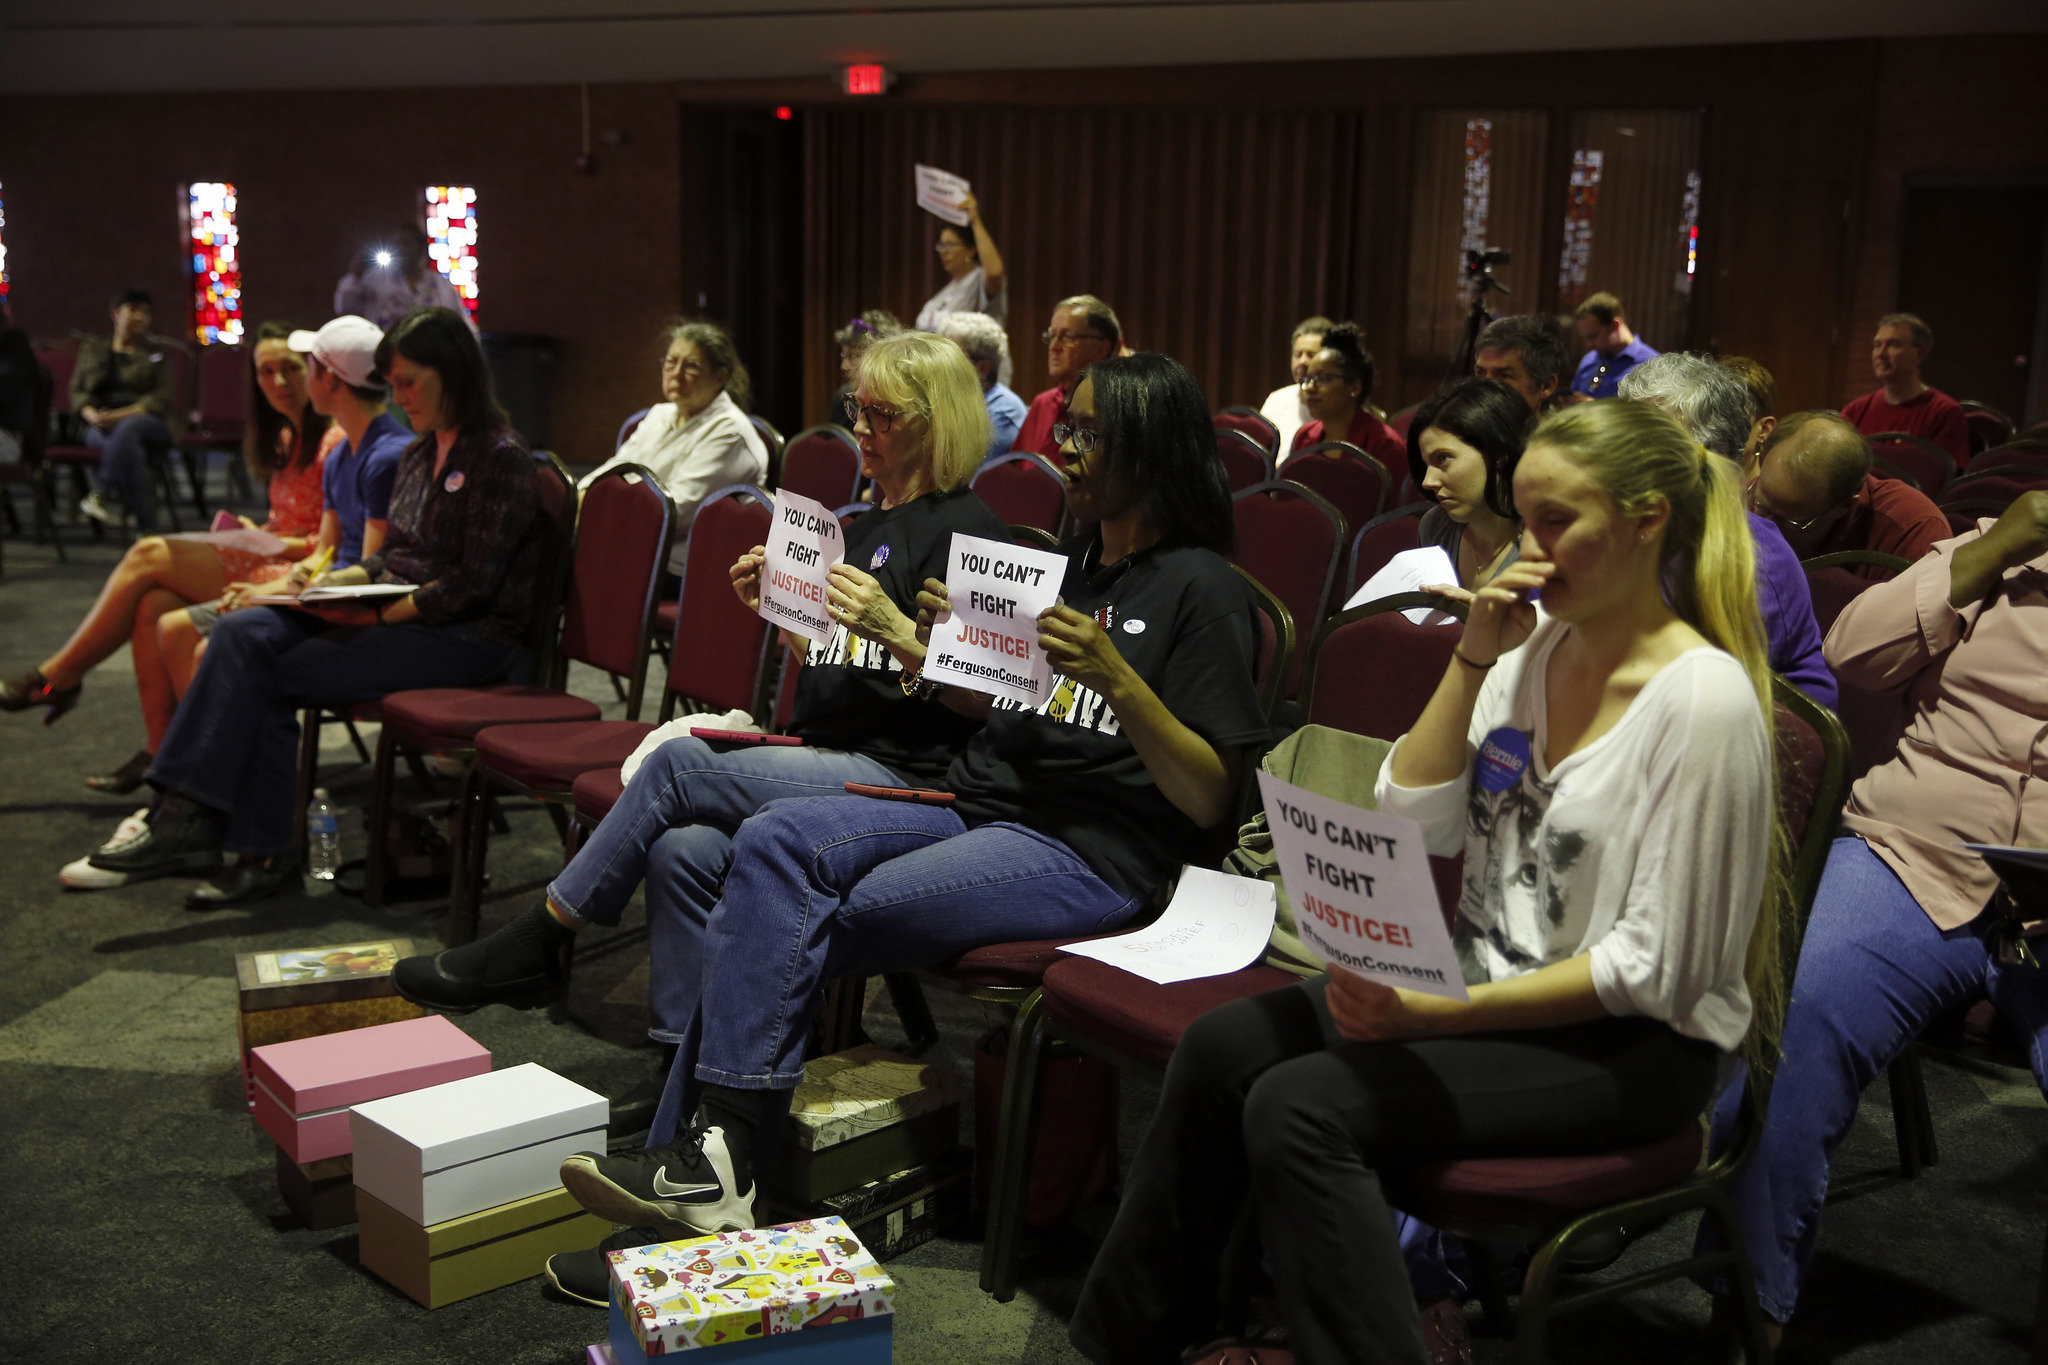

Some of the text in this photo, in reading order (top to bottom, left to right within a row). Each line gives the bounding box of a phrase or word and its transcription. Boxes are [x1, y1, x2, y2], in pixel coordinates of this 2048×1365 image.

[783, 506, 836, 540] YOU CAN'T
[785, 540, 820, 567] FIGHT
[961, 551, 1046, 587] YOU CAN'T
[771, 569, 823, 604] JUSTICE!
[970, 590, 1017, 619] FIGHT
[763, 594, 829, 632] #FergusonConsent
[956, 624, 1030, 660] JUSTICE!
[936, 652, 1039, 692] #FergusonConsent
[1481, 739, 1523, 771] Bernie
[1276, 798, 1397, 860] YOU CAN'T
[1304, 852, 1375, 898] FIGHT
[1170, 918, 1206, 949] GRIEF
[1302, 892, 1413, 948] JUSTICE!
[1300, 920, 1446, 982] #FergusonConsent
